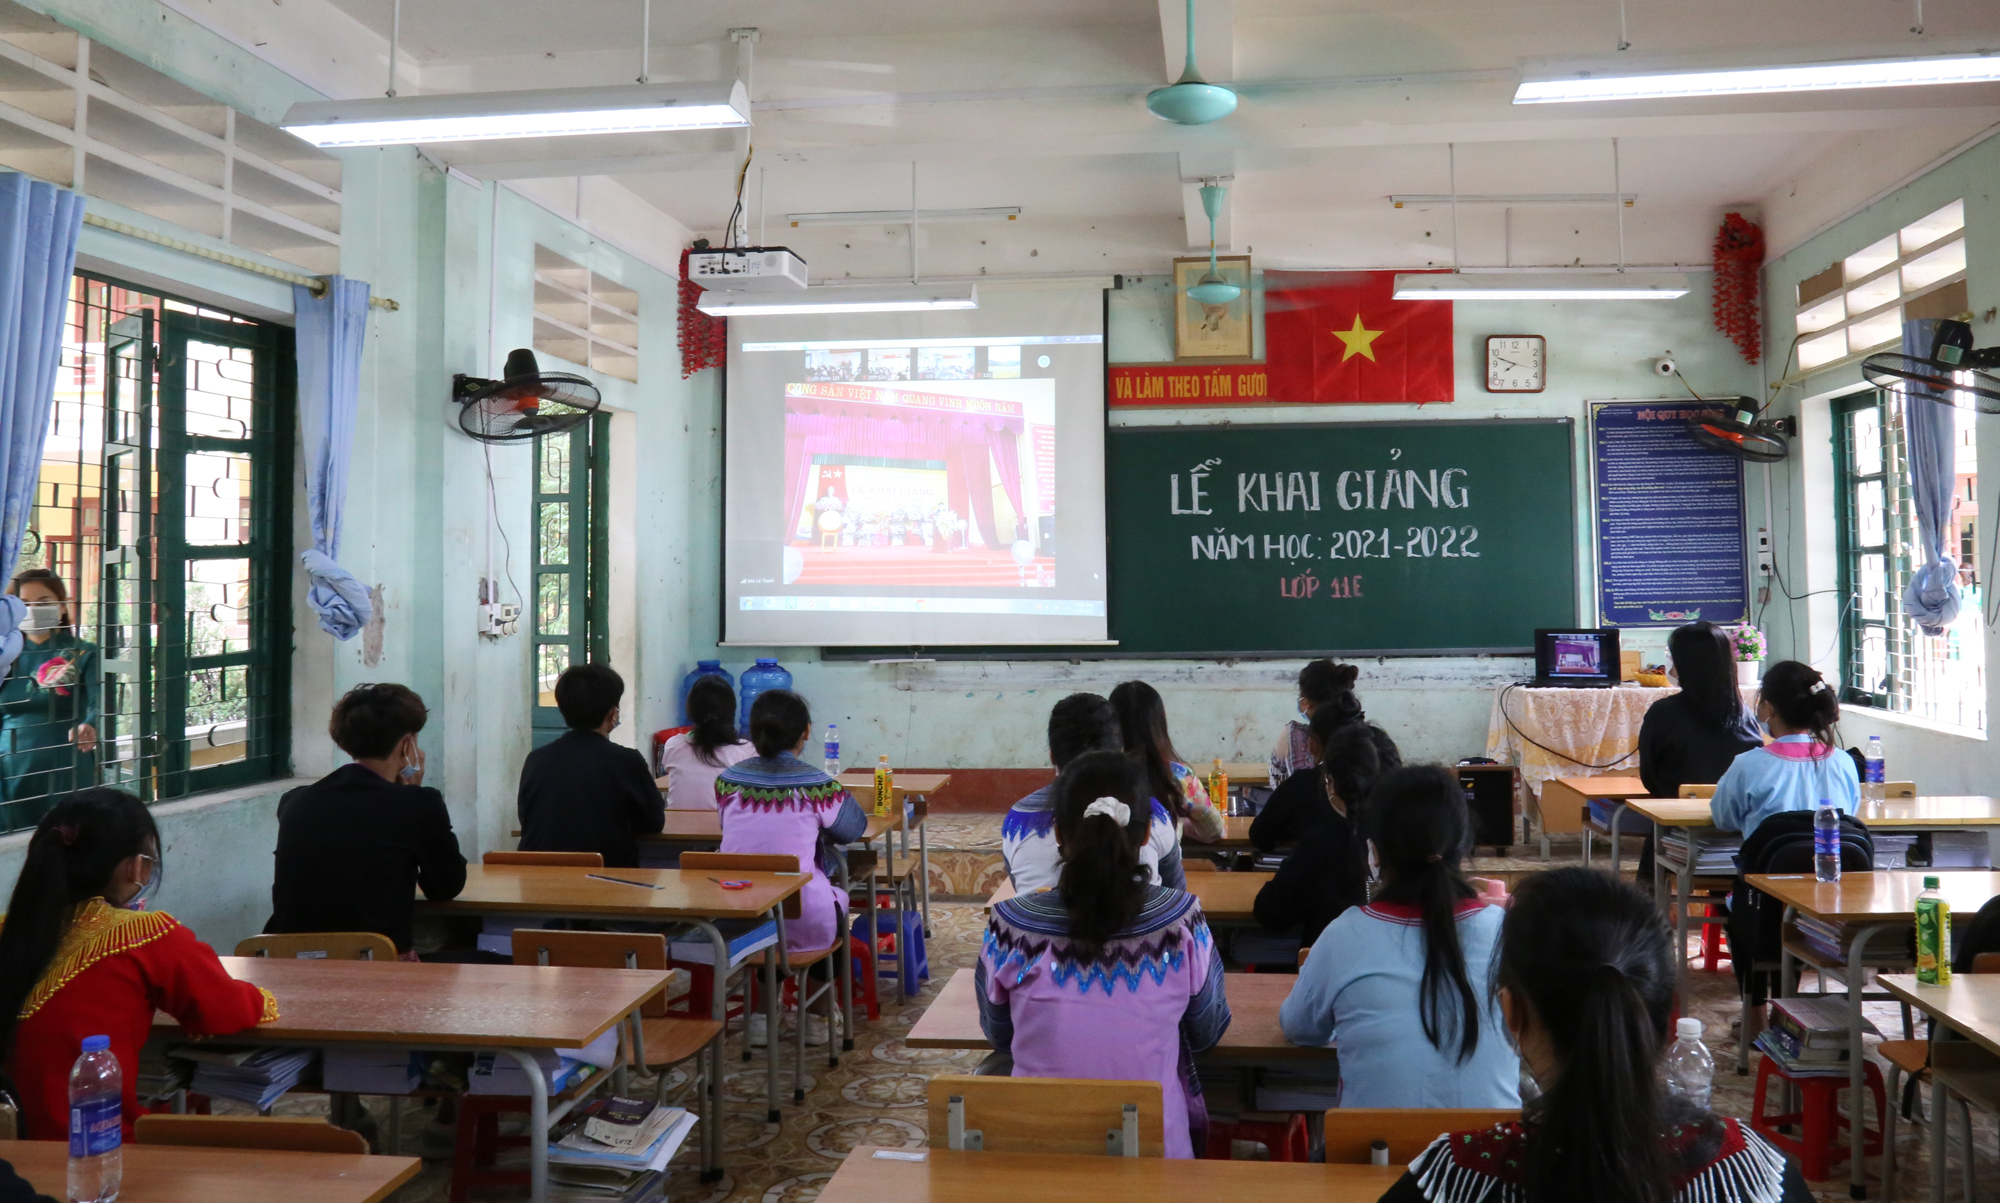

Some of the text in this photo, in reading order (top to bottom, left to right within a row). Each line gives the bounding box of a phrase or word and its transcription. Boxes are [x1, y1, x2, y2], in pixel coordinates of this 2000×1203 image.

[1500, 341, 1506, 349] 11
[1511, 341, 1519, 349] 12
[1526, 341, 1530, 349] 1
[1493, 360, 1498, 368] 9
[1533, 360, 1538, 368] 3
[1115, 368, 1268, 399] VÀ LÀM THEO TẤM GƯƠ
[1500, 379, 1505, 387] 7
[1525, 379, 1531, 387] 5
[902, 393, 936, 406] QUANG
[938, 396, 963, 408] VINH
[1636, 408, 1656, 422] NỘI
[1656, 410, 1678, 421] QUY
[1170, 448, 1470, 515] LỄ KHAI GIẢNG
[1191, 525, 1481, 566] NĂM HỌC: 2021-2022
[1280, 567, 1364, 598] LỚP 11E
